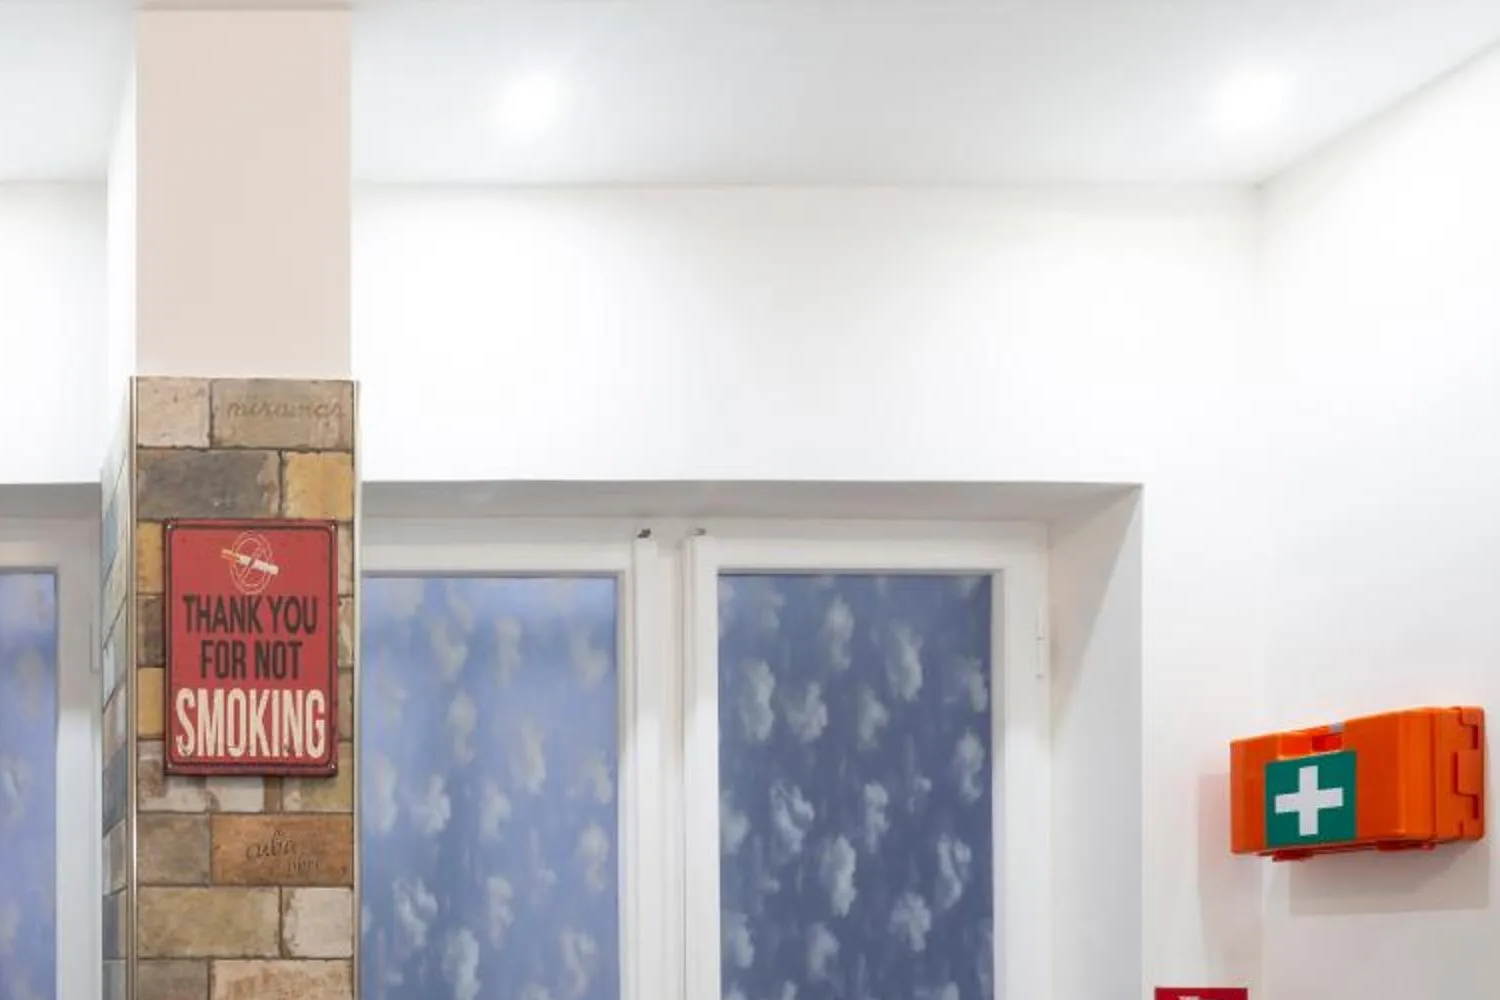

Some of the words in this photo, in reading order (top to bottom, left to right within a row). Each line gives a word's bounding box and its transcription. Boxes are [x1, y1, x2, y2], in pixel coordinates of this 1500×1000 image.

[183, 594, 264, 634] THANK
[268, 594, 319, 634] YOU
[200, 639, 248, 680] FOR
[255, 640, 304, 680] NOT
[175, 688, 326, 759] SMOKING
